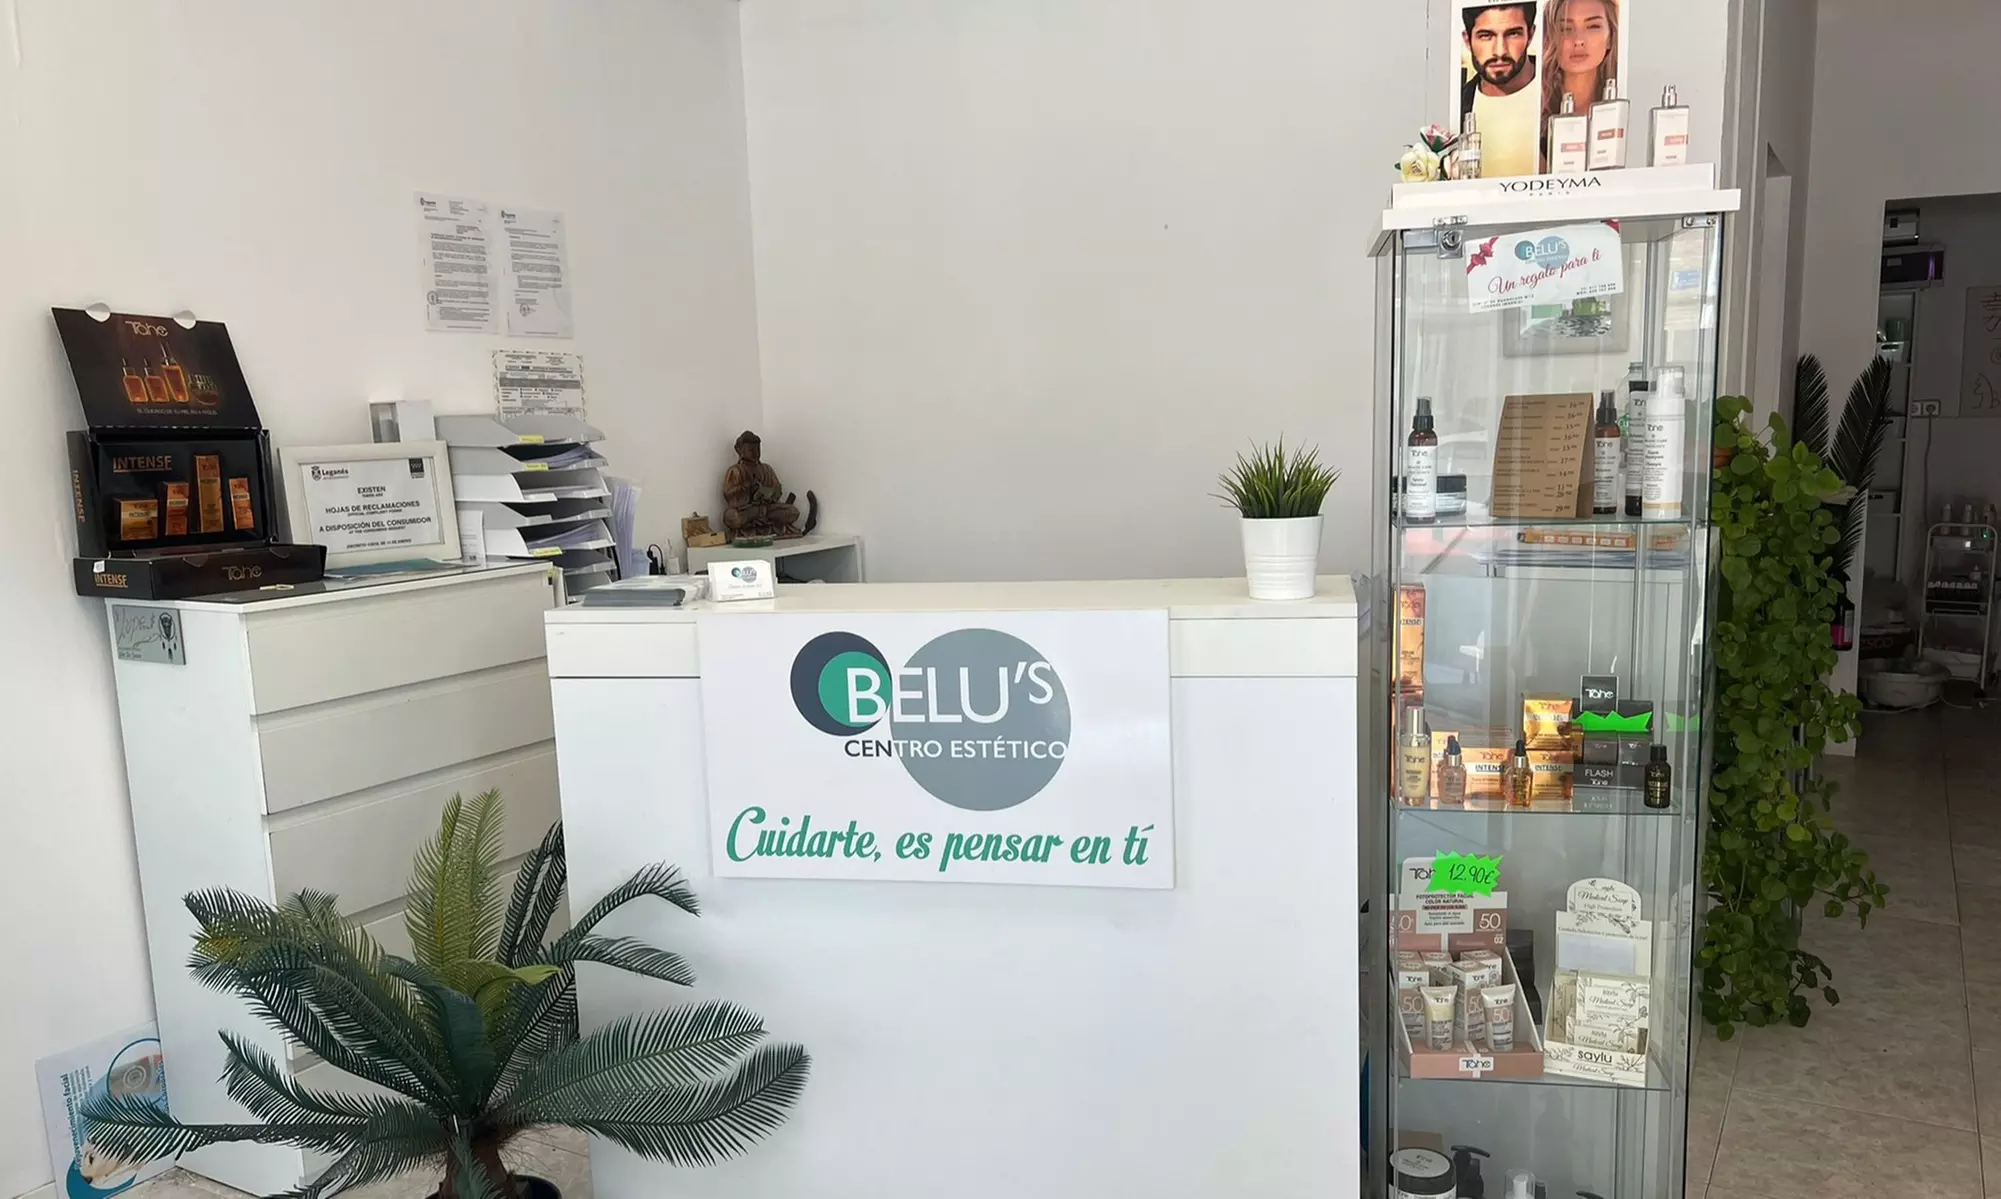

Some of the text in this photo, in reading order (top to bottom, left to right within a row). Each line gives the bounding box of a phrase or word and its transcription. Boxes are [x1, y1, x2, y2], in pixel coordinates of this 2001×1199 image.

[1500, 177, 1601, 192] YODEYMA
[1525, 241, 1567, 258] BELU'S
[1488, 276, 1516, 294] Un
[1520, 264, 1556, 289] regalo
[1559, 256, 1588, 278] para
[112, 455, 172, 471] INTENSE
[72, 470, 85, 523] INTENSE
[358, 486, 386, 494] EXISTEN
[326, 506, 350, 514] HOJAS
[362, 500, 420, 510] RECLAMACIONES
[326, 520, 370, 532] DISPOSICIÓN
[387, 517, 432, 527] CONSUMIDOR
[94, 573, 128, 587] INTENSE
[847, 662, 1054, 724] BELU'S
[844, 735, 1067, 759] CENTRO ESTÉTICO
[1535, 764, 1562, 772] INTENSE
[1584, 768, 1614, 777] FLASH
[726, 806, 1155, 872] Cuidarte, es pensar en tí
[1409, 868, 1436, 880] Tah
[1449, 864, 1495, 885] 12.90€
[1494, 936, 1504, 944] 02
[1578, 1050, 1612, 1064] saylu
[60, 1074, 82, 1170] Rejuvenecimiento facial
